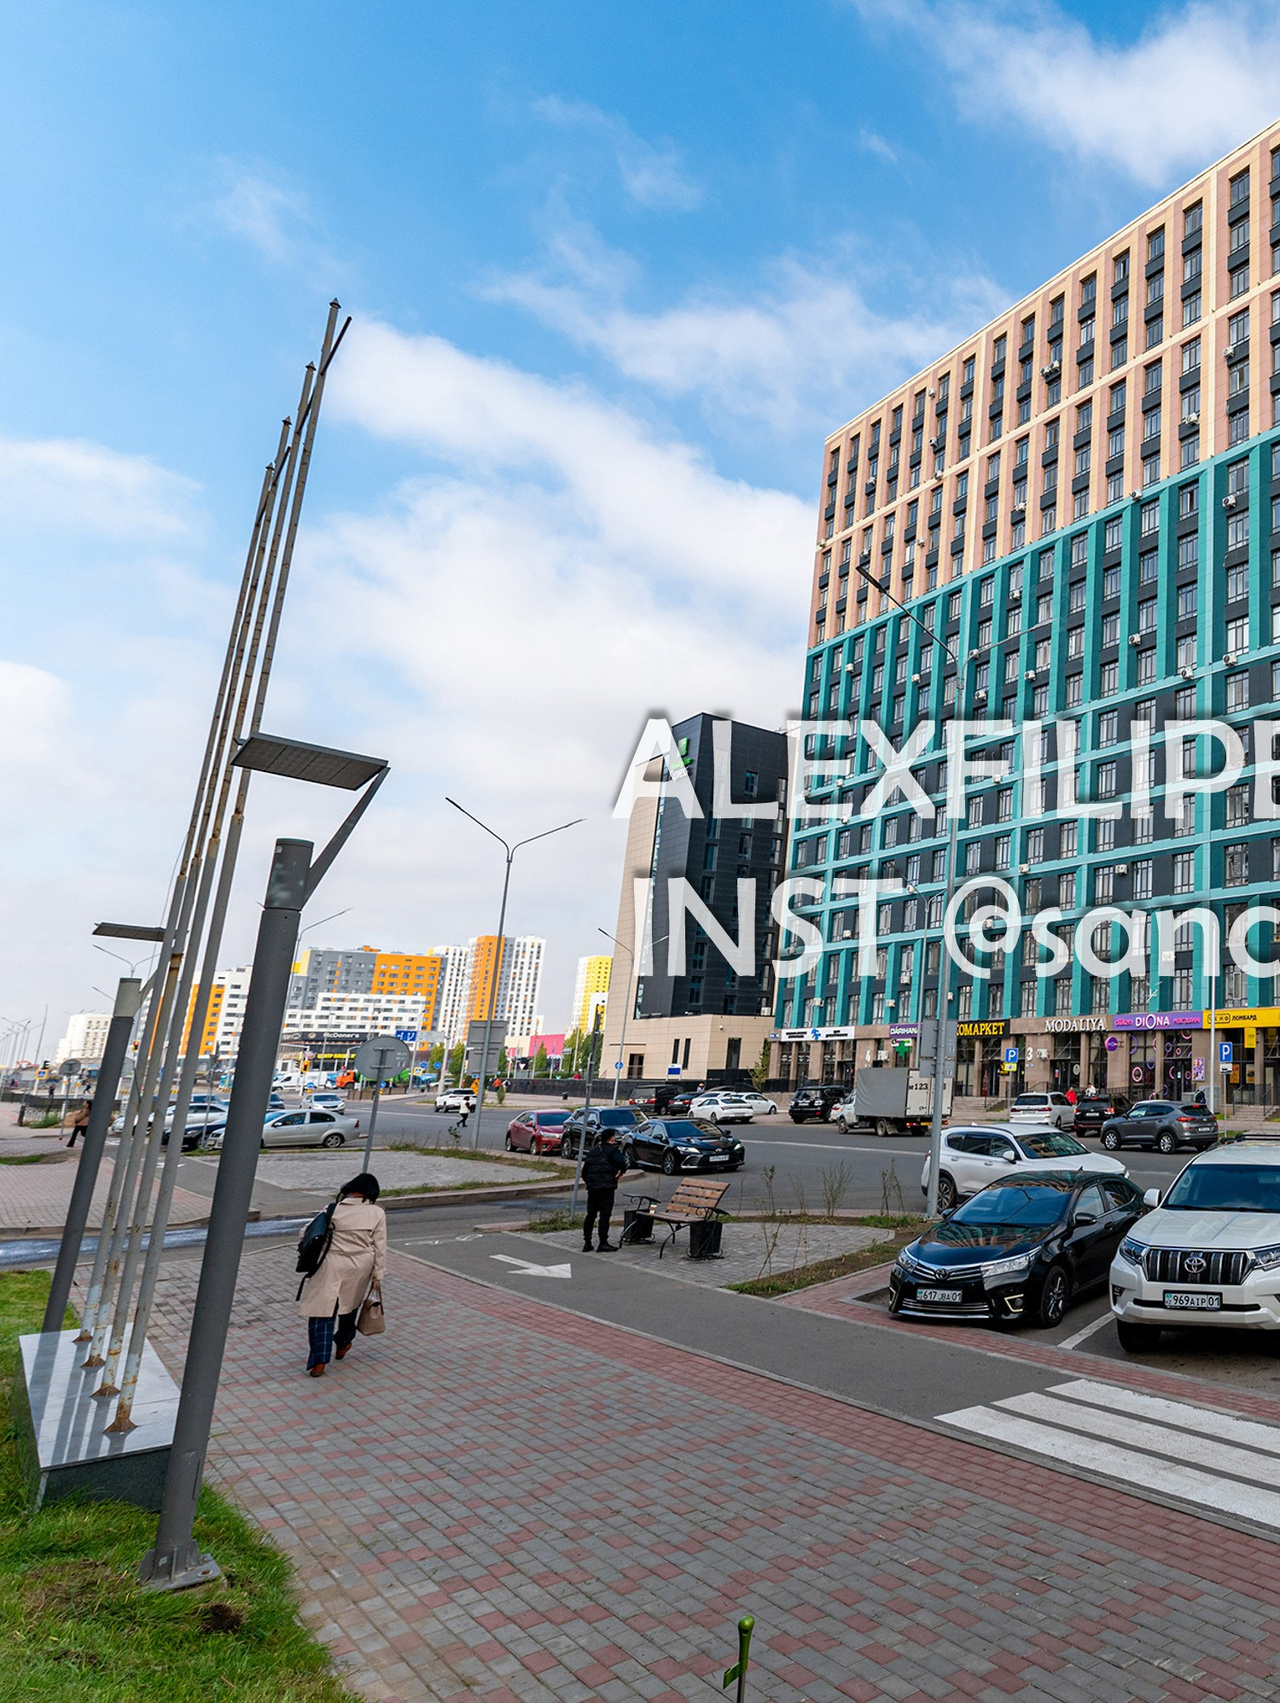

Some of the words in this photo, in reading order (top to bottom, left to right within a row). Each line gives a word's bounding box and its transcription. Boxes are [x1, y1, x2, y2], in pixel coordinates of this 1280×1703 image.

[1044, 1018, 1107, 1032] MODALIYA
[1135, 1013, 1170, 1030] DIONA
[1026, 1047, 1033, 1061] 3
[1208, 1296, 1220, 1307] 01
